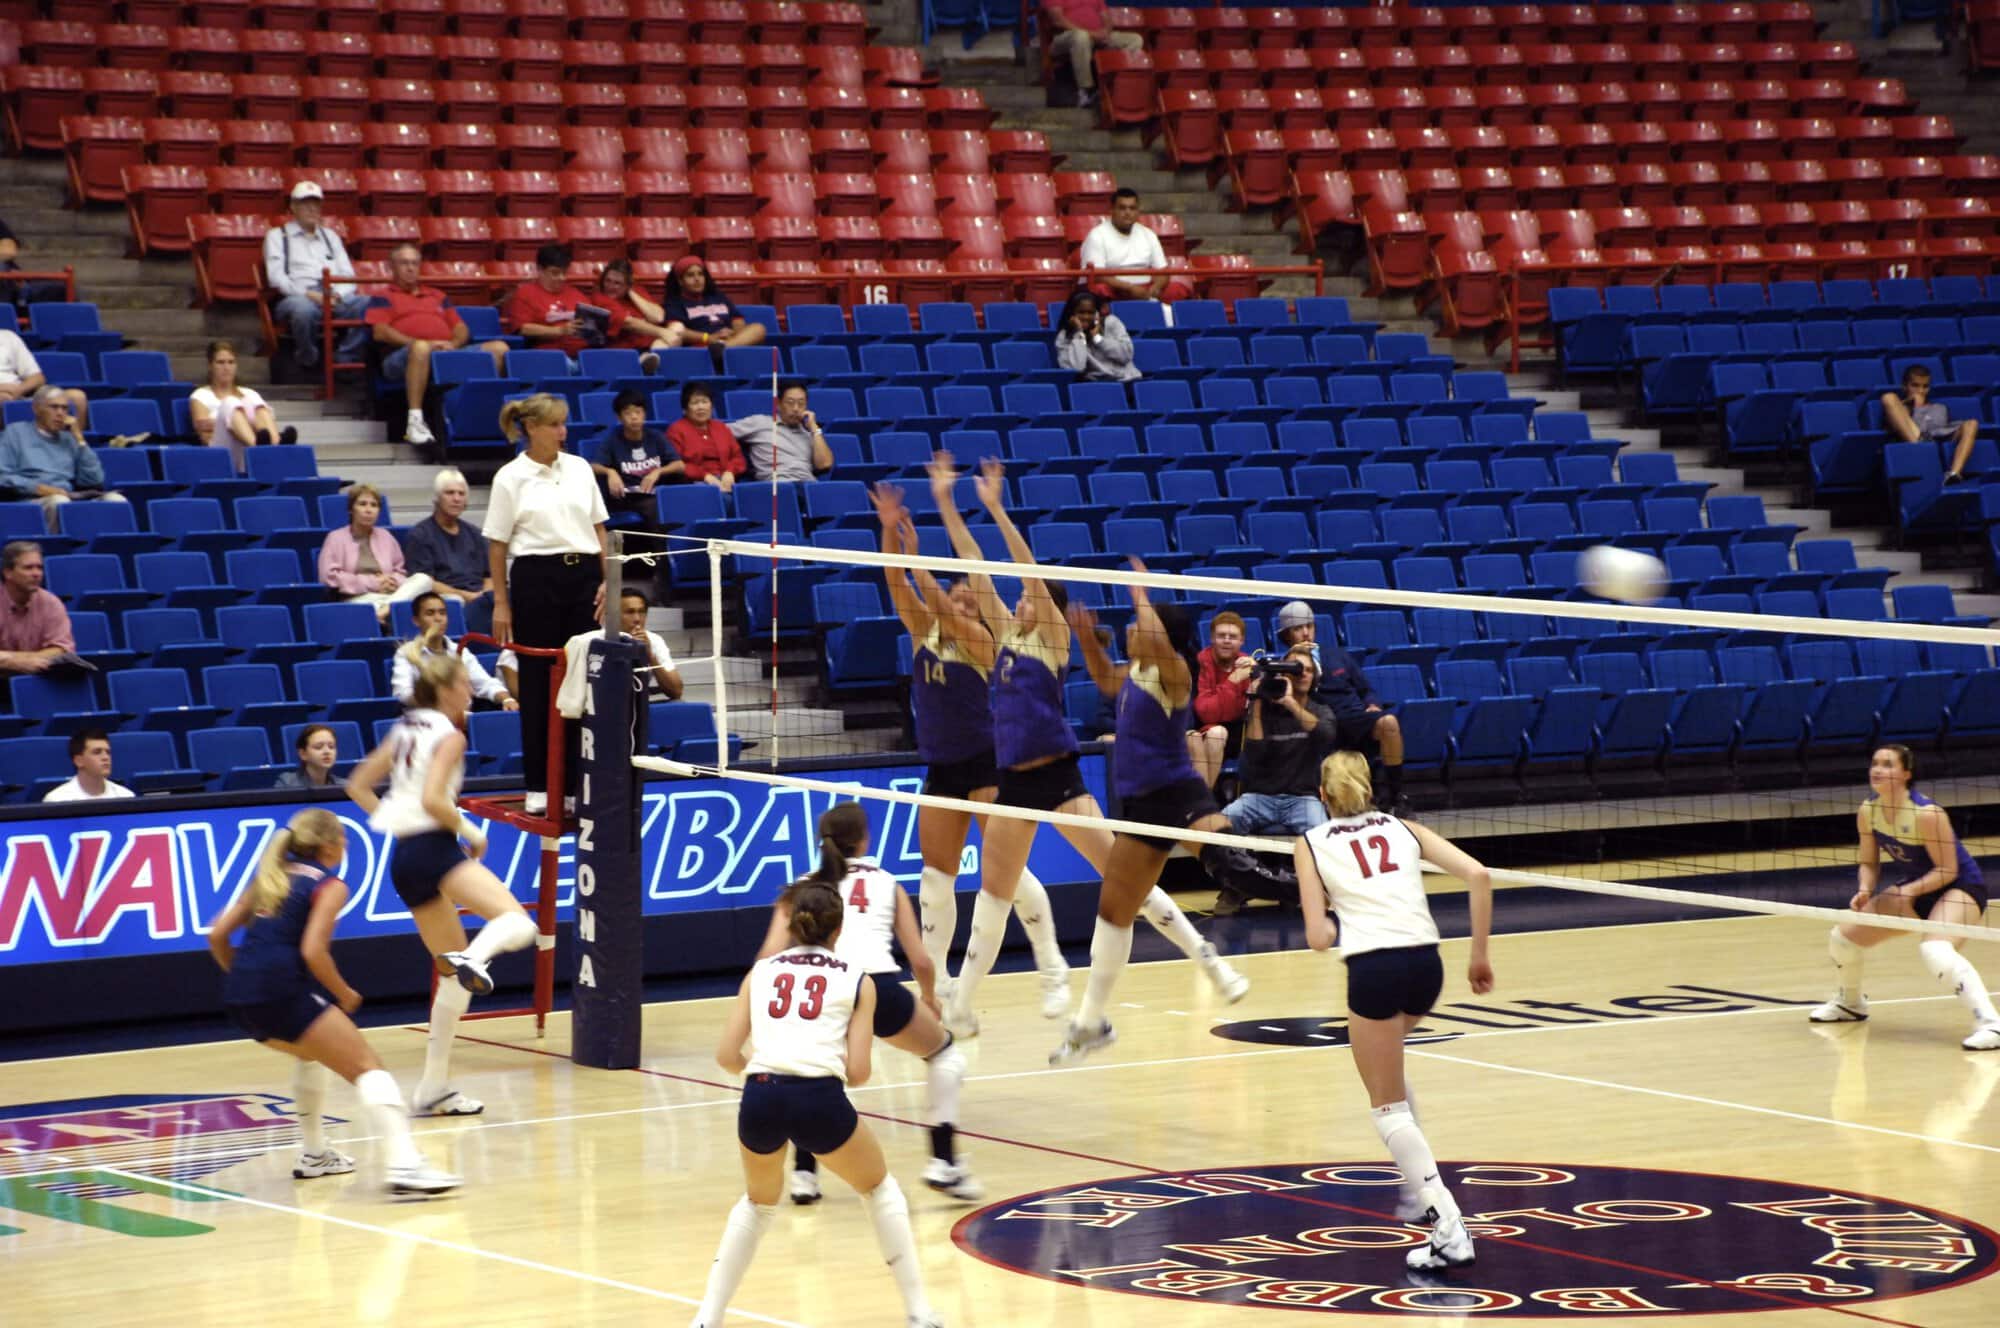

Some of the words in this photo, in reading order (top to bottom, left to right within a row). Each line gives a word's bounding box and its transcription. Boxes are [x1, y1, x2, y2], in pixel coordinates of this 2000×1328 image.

[1888, 263, 1908, 279] 17
[864, 284, 888, 304] 16
[923, 658, 947, 687] 14
[1349, 835, 1399, 879] 12
[848, 878, 870, 913] 4
[770, 953, 848, 972] ARIZONA
[768, 973, 827, 1020] 33
[996, 1165, 1576, 1230] COURT
[1728, 1194, 1978, 1274] LUTE
[1052, 1258, 1682, 1312] BOBBI
